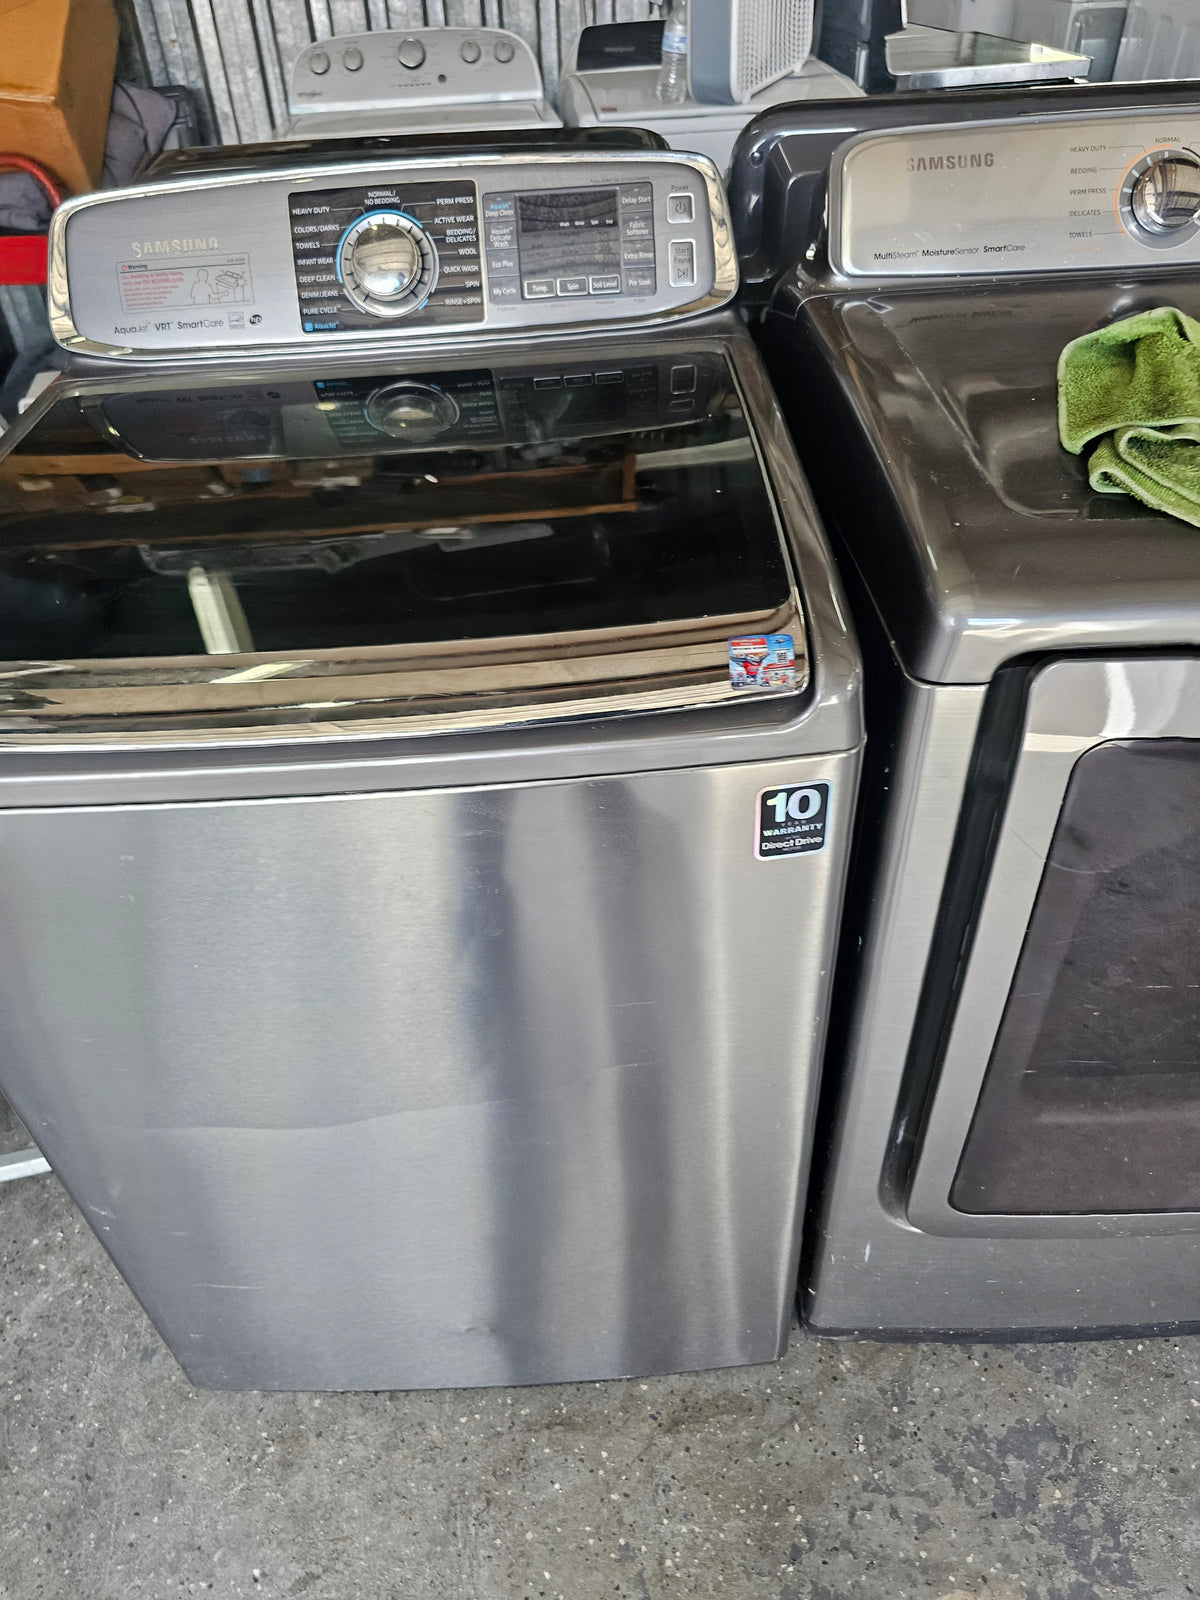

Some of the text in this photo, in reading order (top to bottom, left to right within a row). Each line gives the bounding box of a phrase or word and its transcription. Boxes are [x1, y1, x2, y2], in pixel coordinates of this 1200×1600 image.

[906, 152, 994, 172] SAMSUNG
[1070, 167, 1098, 175] BEDDING
[670, 184, 689, 192] Power
[1069, 188, 1087, 196] PERM
[368, 190, 396, 199] NORMAL/
[364, 197, 401, 206] NO BEDDING
[436, 196, 474, 206] PERM PRESS
[621, 197, 637, 205] Delay
[292, 206, 330, 216] HEAVY DUTY
[485, 210, 499, 218] Deep
[1069, 209, 1101, 217] DELICATES
[434, 215, 475, 225] ACTIVE WEAR
[294, 224, 340, 234] COLORS/DARKS
[446, 228, 476, 236] BEDDING/
[626, 228, 649, 237] Softener
[445, 235, 477, 243] DELICATES
[1069, 231, 1093, 239] TOWELS
[132, 237, 219, 257] SAMSUNG
[295, 241, 320, 249] TOWELS
[458, 248, 477, 256] WOOL
[674, 247, 690, 255] Start
[921, 246, 980, 257] MoistureSensor
[983, 244, 1026, 254] SmartCare
[624, 251, 654, 260] Extra Rinse
[297, 257, 334, 266] INFANT WEAR
[443, 265, 479, 274] QUICK WASH
[299, 274, 336, 283] DEEP CLEAN
[566, 283, 579, 291] Spin
[603, 280, 617, 288] Level
[301, 290, 339, 299] DENIM/JEANS
[303, 306, 338, 315] PURE CYCLE
[177, 319, 224, 330] SmartCare
[766, 788, 822, 823] 10
[763, 823, 823, 837] WARRANTY
[761, 839, 795, 850] Direct
[795, 837, 823, 846] Drive
